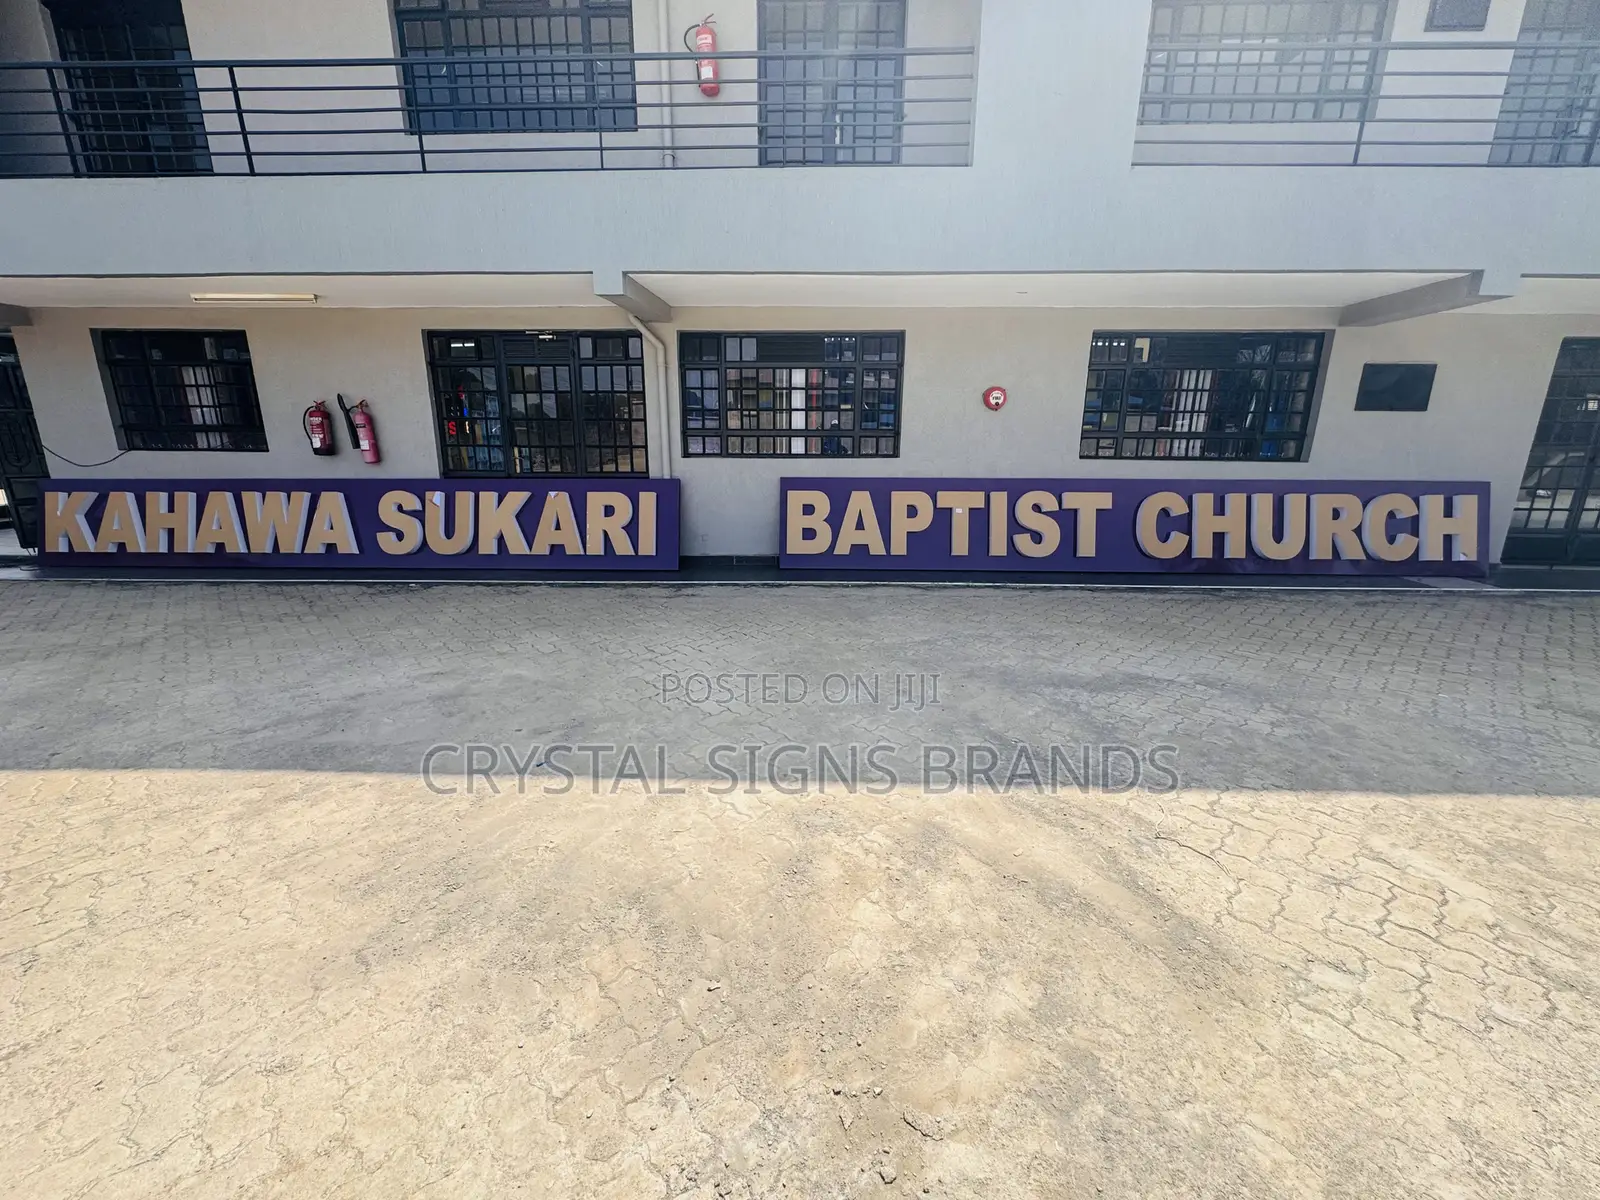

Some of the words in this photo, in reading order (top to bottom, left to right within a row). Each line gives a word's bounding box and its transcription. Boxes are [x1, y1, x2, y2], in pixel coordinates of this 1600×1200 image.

[44, 490, 360, 555] KAHAWA
[376, 490, 657, 556] SUKARI
[785, 490, 1113, 558] BAPTIST
[1135, 491, 1480, 562] CHURCH
